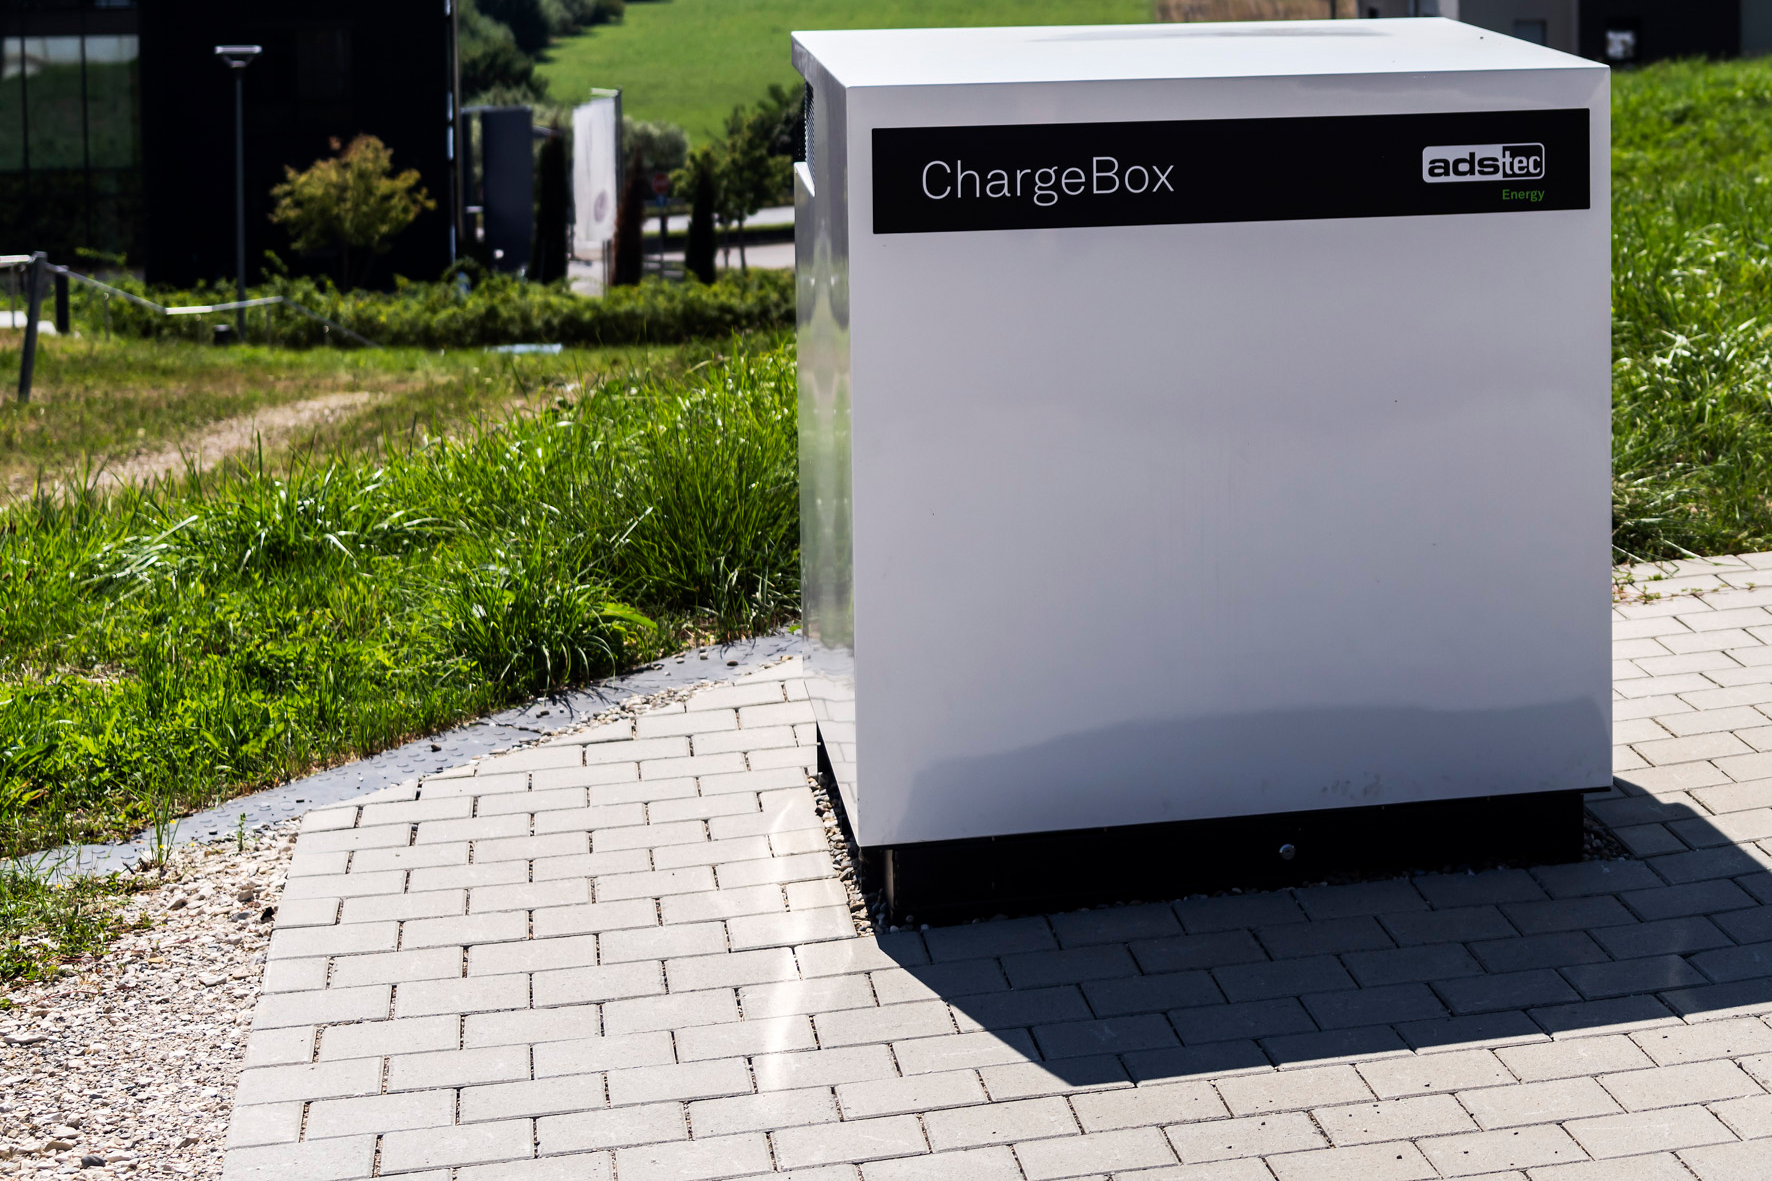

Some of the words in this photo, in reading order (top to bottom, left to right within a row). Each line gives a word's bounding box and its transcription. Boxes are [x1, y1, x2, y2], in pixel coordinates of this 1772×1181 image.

[1427, 150, 1542, 178] adstec
[921, 156, 1175, 207] ChargeBox
[1501, 188, 1545, 202] Energy
